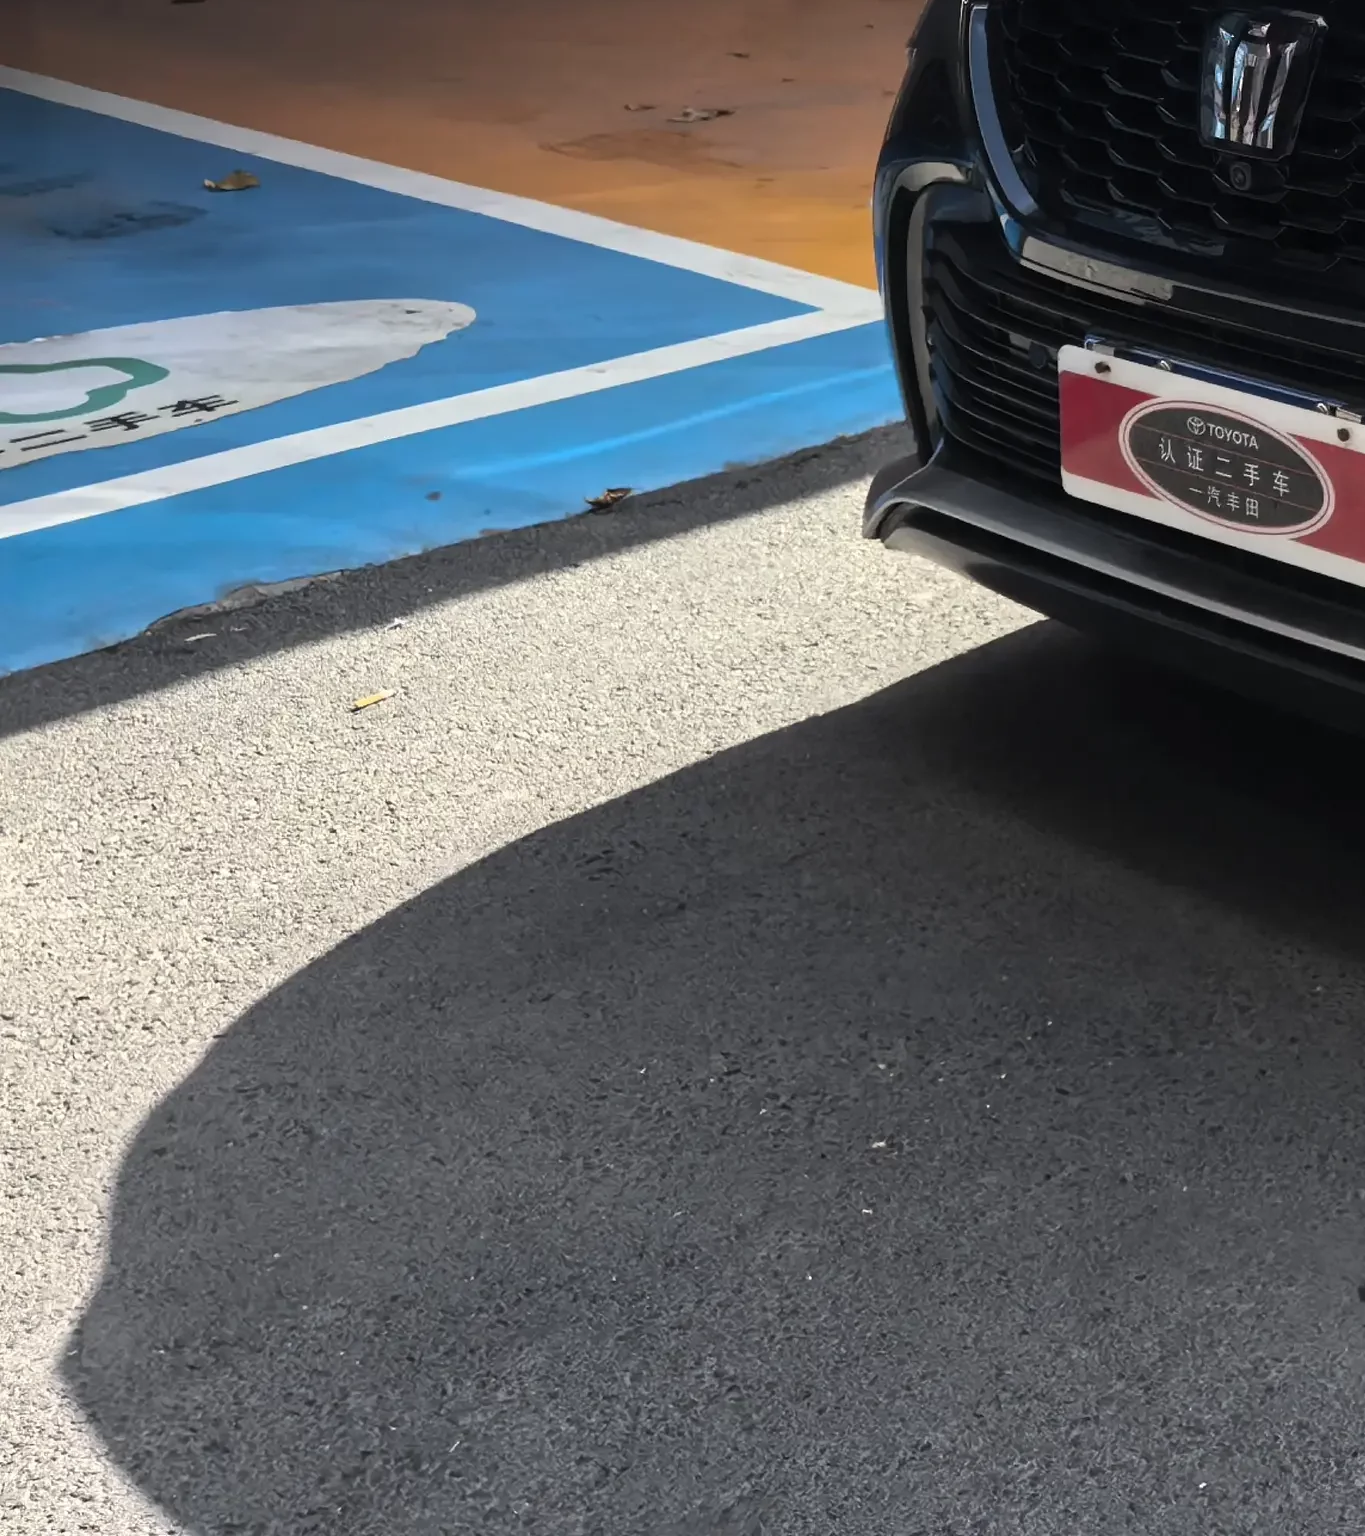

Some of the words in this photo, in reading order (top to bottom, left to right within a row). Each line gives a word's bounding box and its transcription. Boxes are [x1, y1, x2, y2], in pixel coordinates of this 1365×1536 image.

[0, 394, 240, 453] 二手车
[1207, 423, 1259, 450] TOYOTA
[1158, 437, 1290, 497] 认证二手车
[1189, 484, 1260, 519] 一汽丰田
